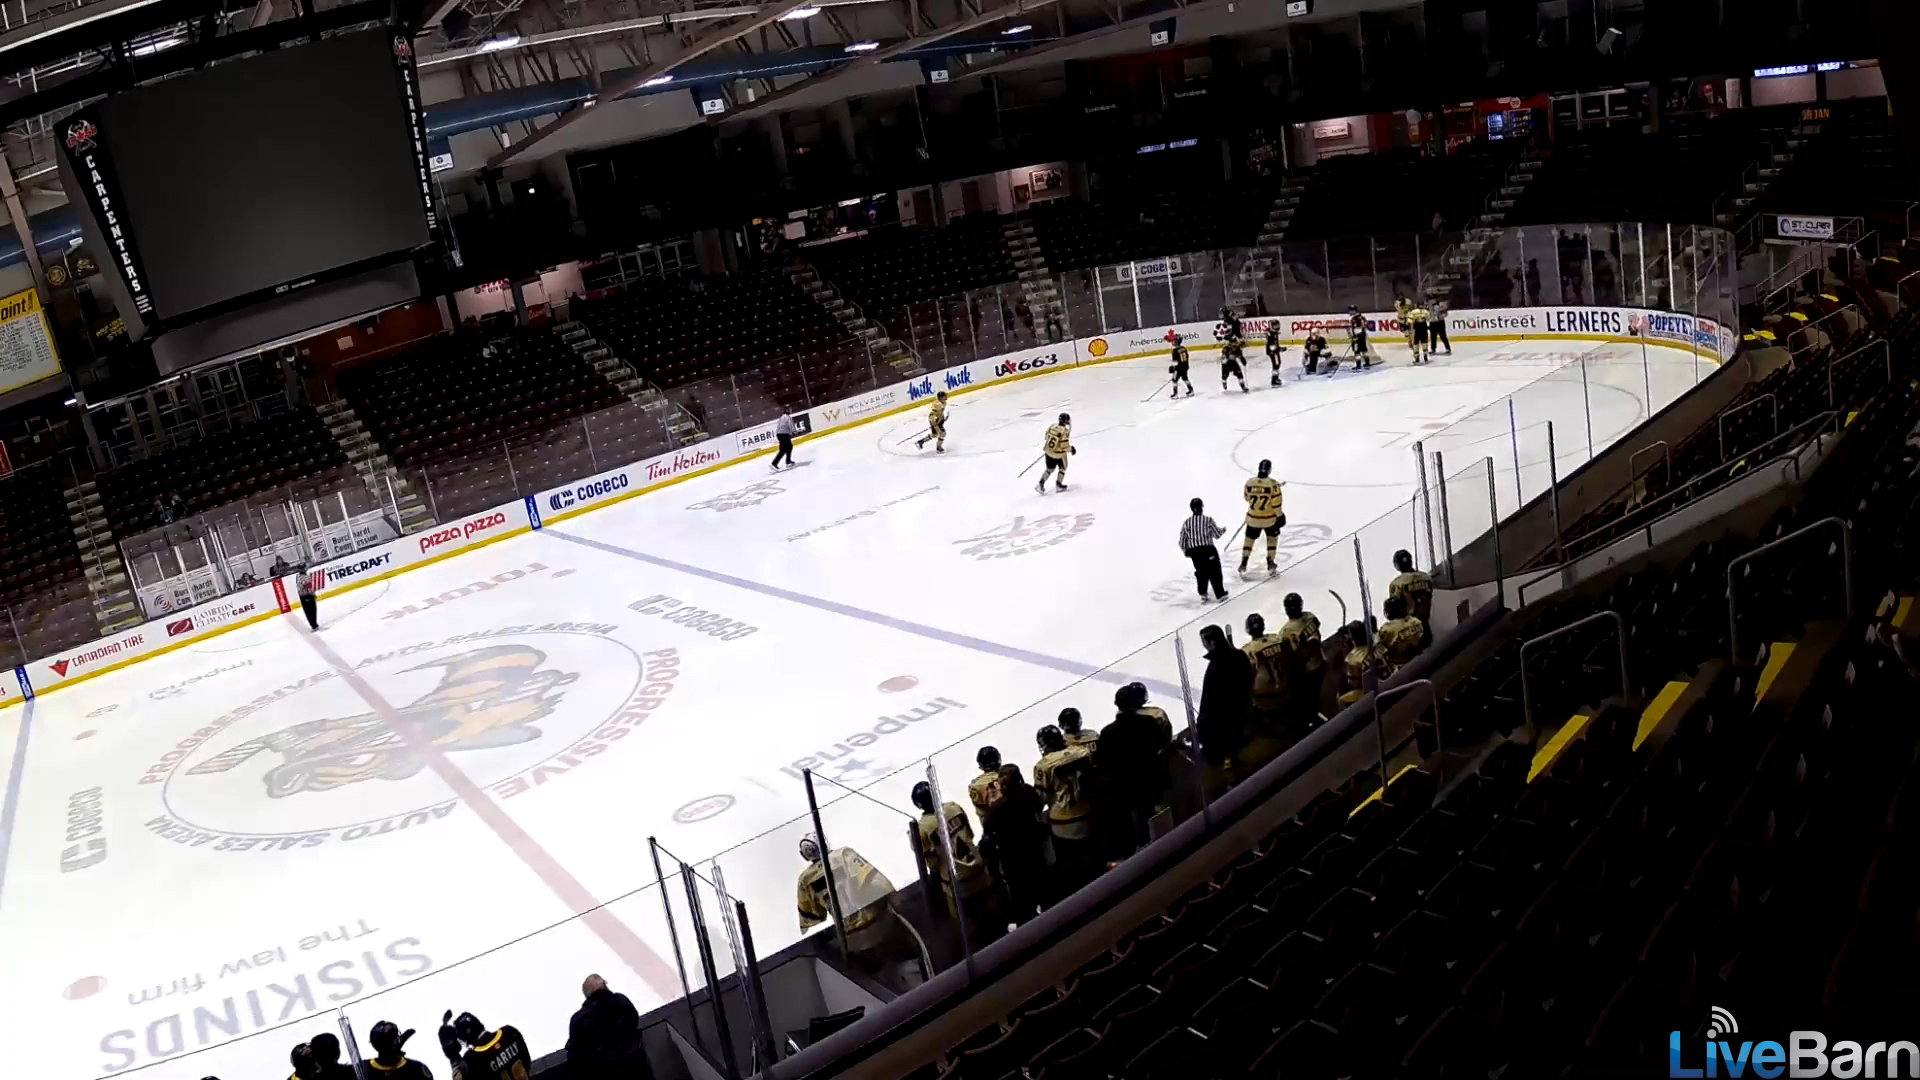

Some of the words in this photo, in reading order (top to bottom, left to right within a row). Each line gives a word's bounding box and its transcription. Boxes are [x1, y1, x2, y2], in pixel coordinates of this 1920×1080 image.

[404, 70, 432, 208] CARPENTERS
[85, 154, 142, 293] CARPENTERS
[0, 297, 27, 321] oint
[1452, 314, 1537, 330] mainstreet
[1546, 310, 1622, 333] LERNERS
[1129, 335, 1165, 348] Anderso
[1018, 353, 1058, 371] 663
[645, 460, 671, 481] Tim
[673, 449, 721, 473] Hortons
[1250, 494, 1269, 511] 77
[420, 526, 461, 555] pizza
[464, 512, 506, 540] pizza
[327, 552, 391, 582] TIRECRAFT
[72, 642, 122, 667] CANADIAN
[121, 633, 145, 649] TIRE
[491, 647, 681, 800] PROGRESSIVE
[779, 695, 967, 782] Imperial
[340, 801, 457, 842] AUTO
[212, 832, 332, 852] SALES
[298, 917, 380, 952] The
[218, 945, 287, 979] law
[99, 936, 433, 1073] SISKINDS
[127, 972, 208, 1006] firm
[490, 1041, 520, 1072] GARTLY
